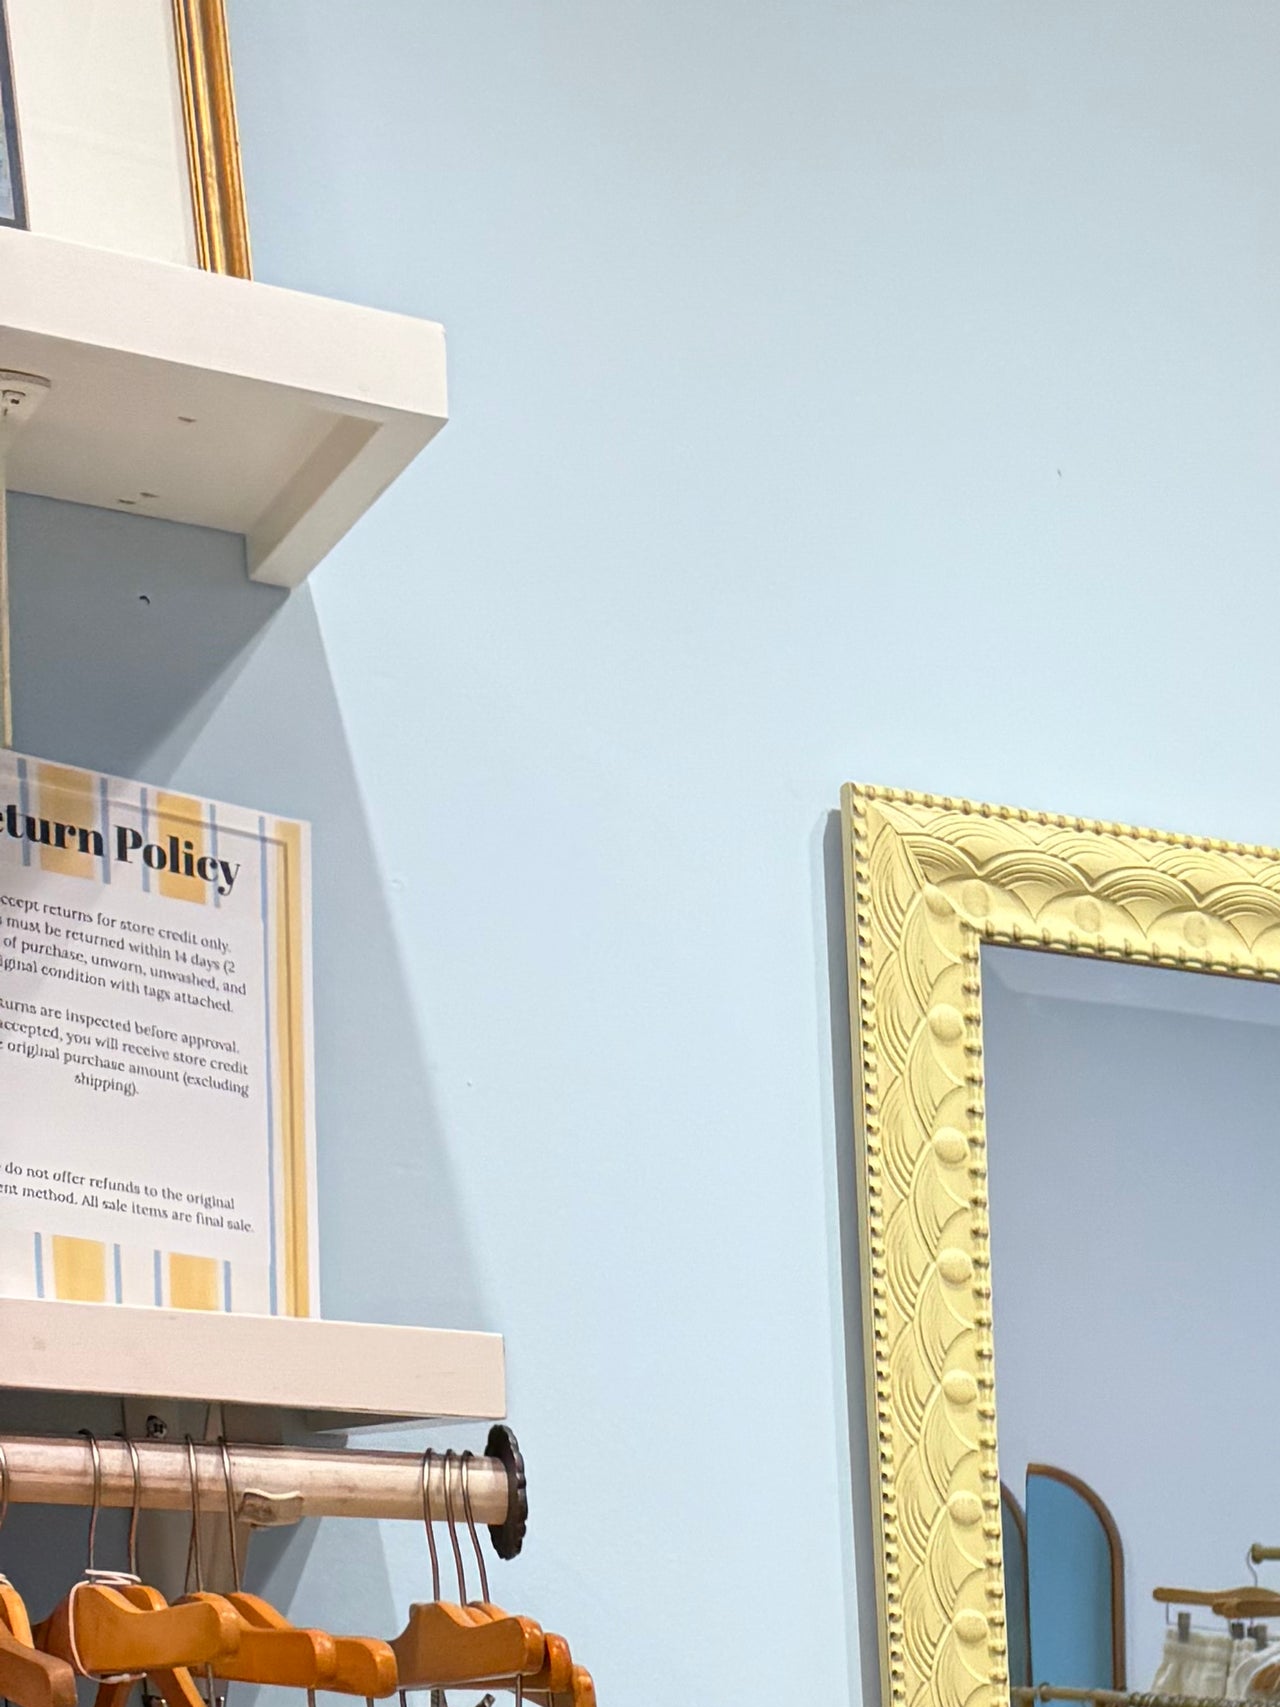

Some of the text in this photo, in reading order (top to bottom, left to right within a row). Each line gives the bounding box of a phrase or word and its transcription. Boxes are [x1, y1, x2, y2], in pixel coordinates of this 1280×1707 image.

[0, 805, 241, 896] turn Policy
[6, 917, 236, 976] must be returned within 14 days (2
[43, 904, 93, 922] returns
[97, 912, 117, 928] for
[120, 920, 155, 936] store
[158, 928, 198, 945] credit
[200, 937, 231, 955] only.
[3, 935, 247, 996] of purchase, unworn, unwashed, and
[41, 965, 106, 987] condition
[110, 979, 140, 994] with
[143, 985, 171, 1003] tags
[174, 991, 233, 1012] attached.
[40, 1006, 62, 1020] are
[66, 1008, 131, 1033] inspected
[134, 1021, 178, 1042] before
[181, 1033, 240, 1053] approval.
[66, 1032, 91, 1045] you
[95, 1036, 119, 1050] will
[122, 1043, 170, 1061] receive
[173, 1052, 207, 1067] store
[210, 1059, 248, 1075] credit
[7, 1041, 249, 1098] original purchase amount (excluding
[74, 1072, 139, 1097] shipping).
[5, 1161, 235, 1209] do not offer refunds to the original
[22, 1187, 78, 1205] method.
[81, 1194, 98, 1208] All
[102, 1198, 127, 1213] sale
[132, 1201, 168, 1219] items
[172, 1210, 192, 1223] are
[196, 1211, 224, 1228] final
